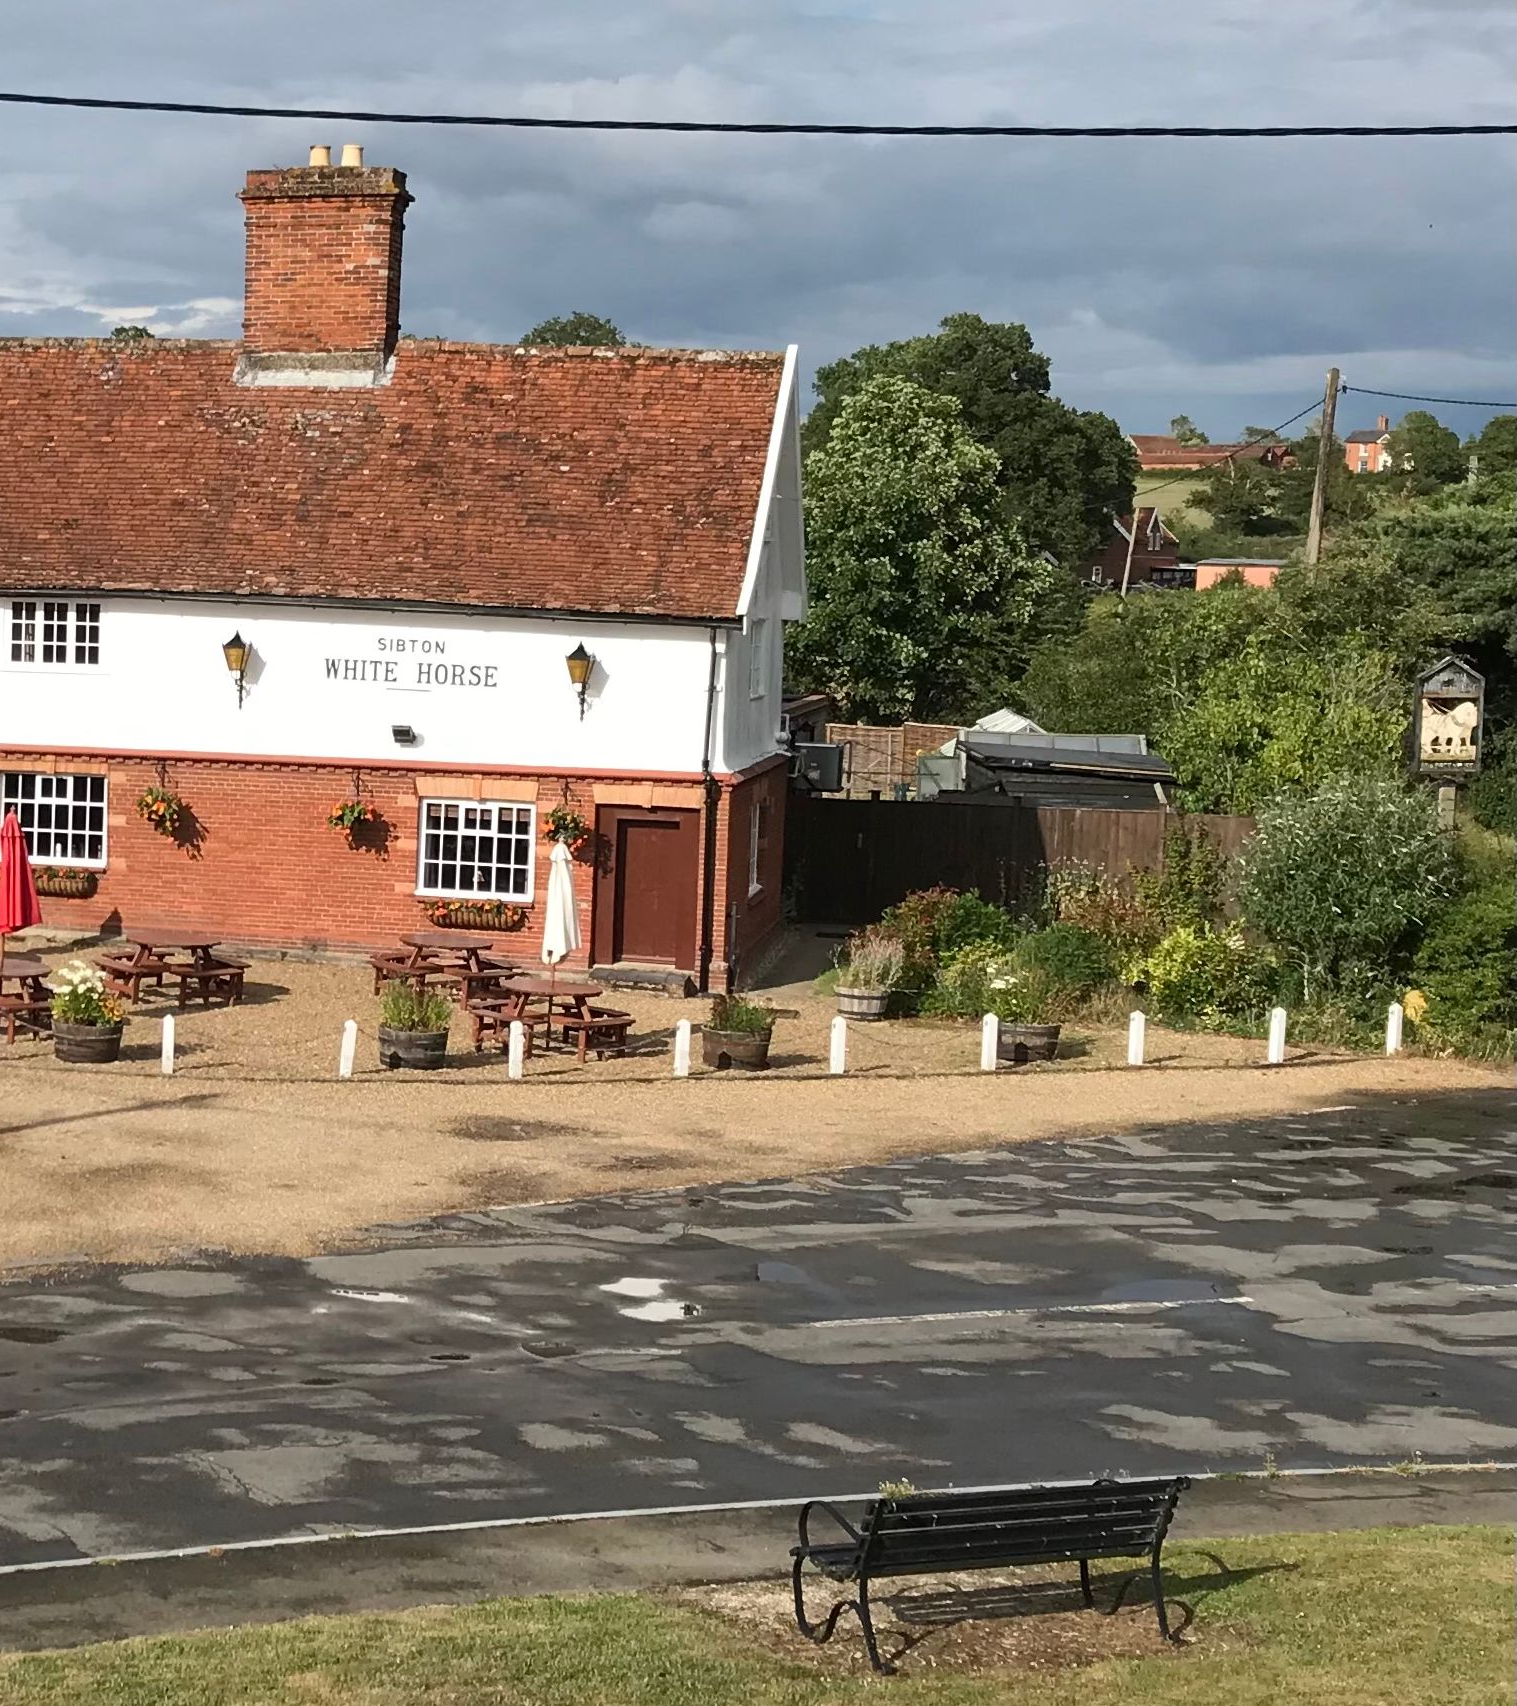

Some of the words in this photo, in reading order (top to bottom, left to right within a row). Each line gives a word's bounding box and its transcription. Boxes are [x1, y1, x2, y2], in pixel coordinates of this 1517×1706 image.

[377, 637, 446, 654] SIBTON
[325, 658, 398, 682] WHITE
[416, 662, 498, 688] HORSE
